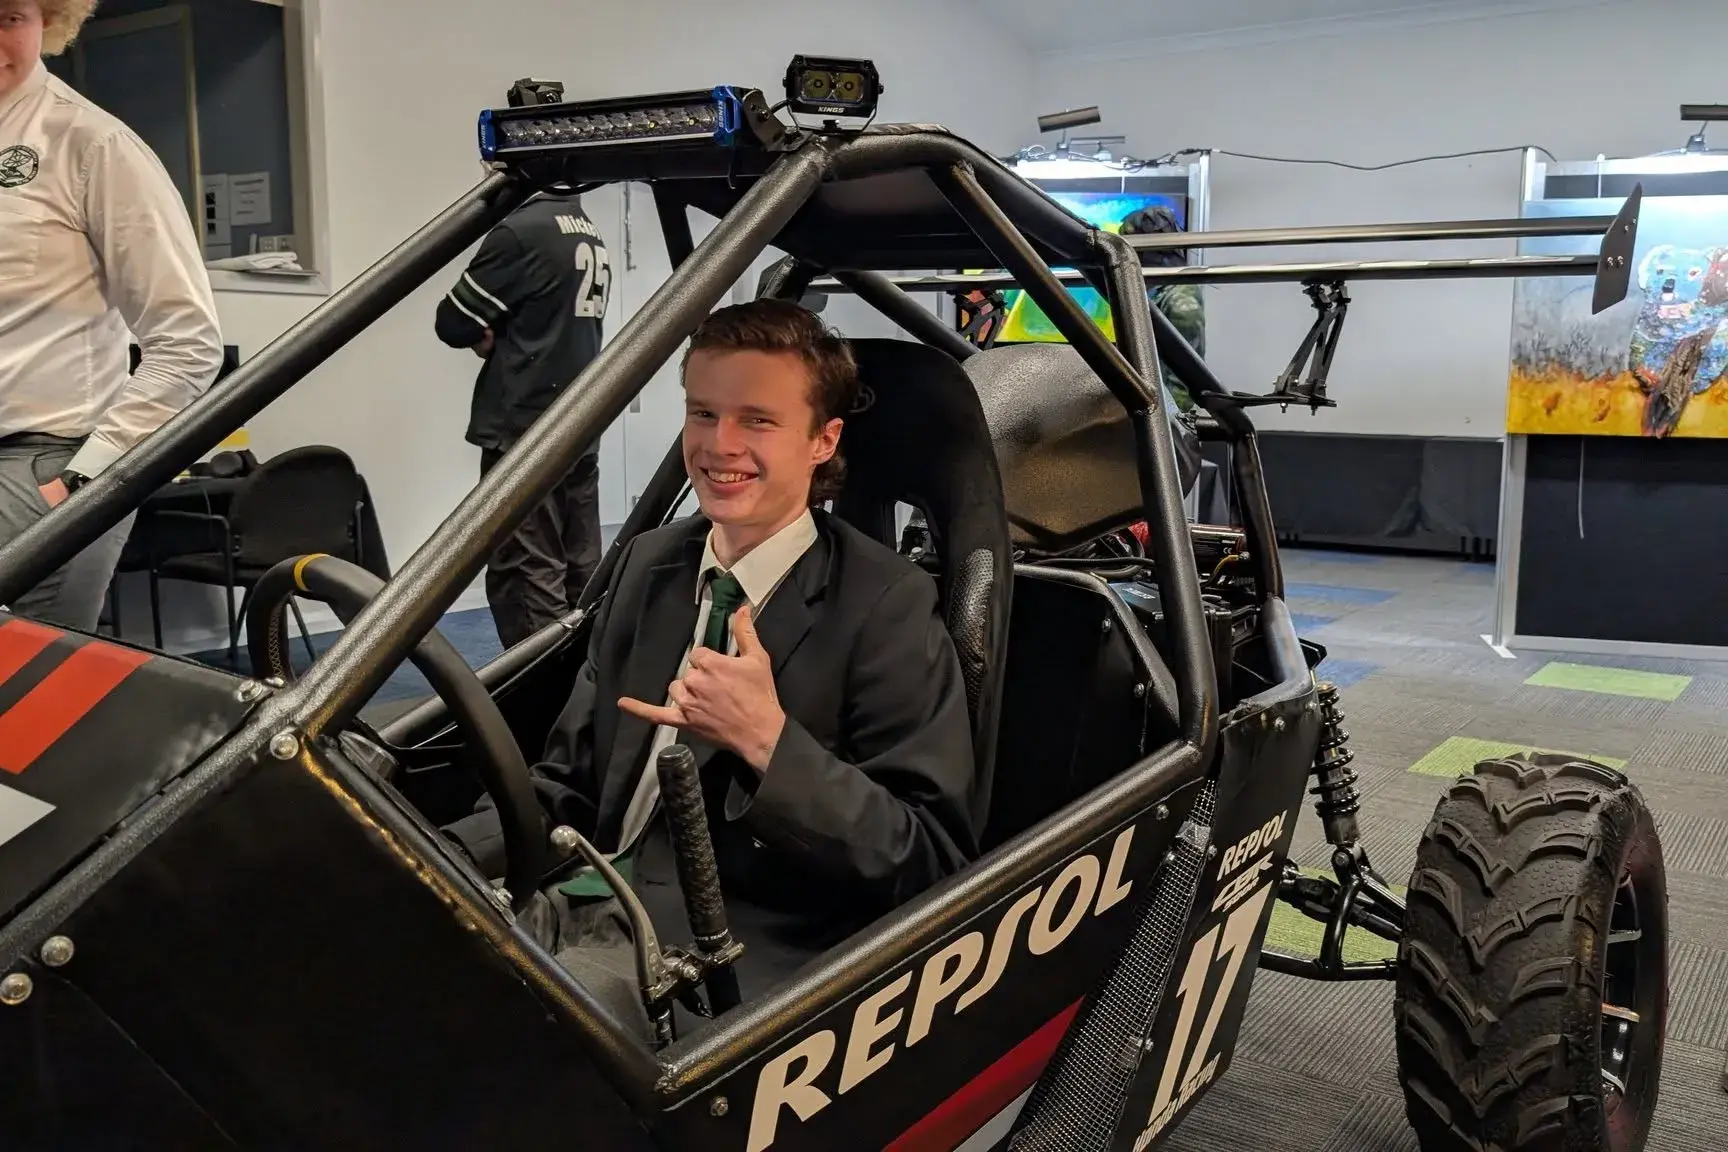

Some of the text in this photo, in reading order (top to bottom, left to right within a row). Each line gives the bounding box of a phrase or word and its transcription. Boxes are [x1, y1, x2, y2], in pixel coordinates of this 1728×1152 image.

[717, 99, 725, 129] KINGS
[817, 106, 846, 114] KINGS
[574, 241, 611, 319] 25
[1211, 848, 1274, 913] CBR
[1216, 809, 1288, 881] REPSOL
[746, 824, 1136, 1152] REPSOL
[1147, 879, 1274, 1127] 17
